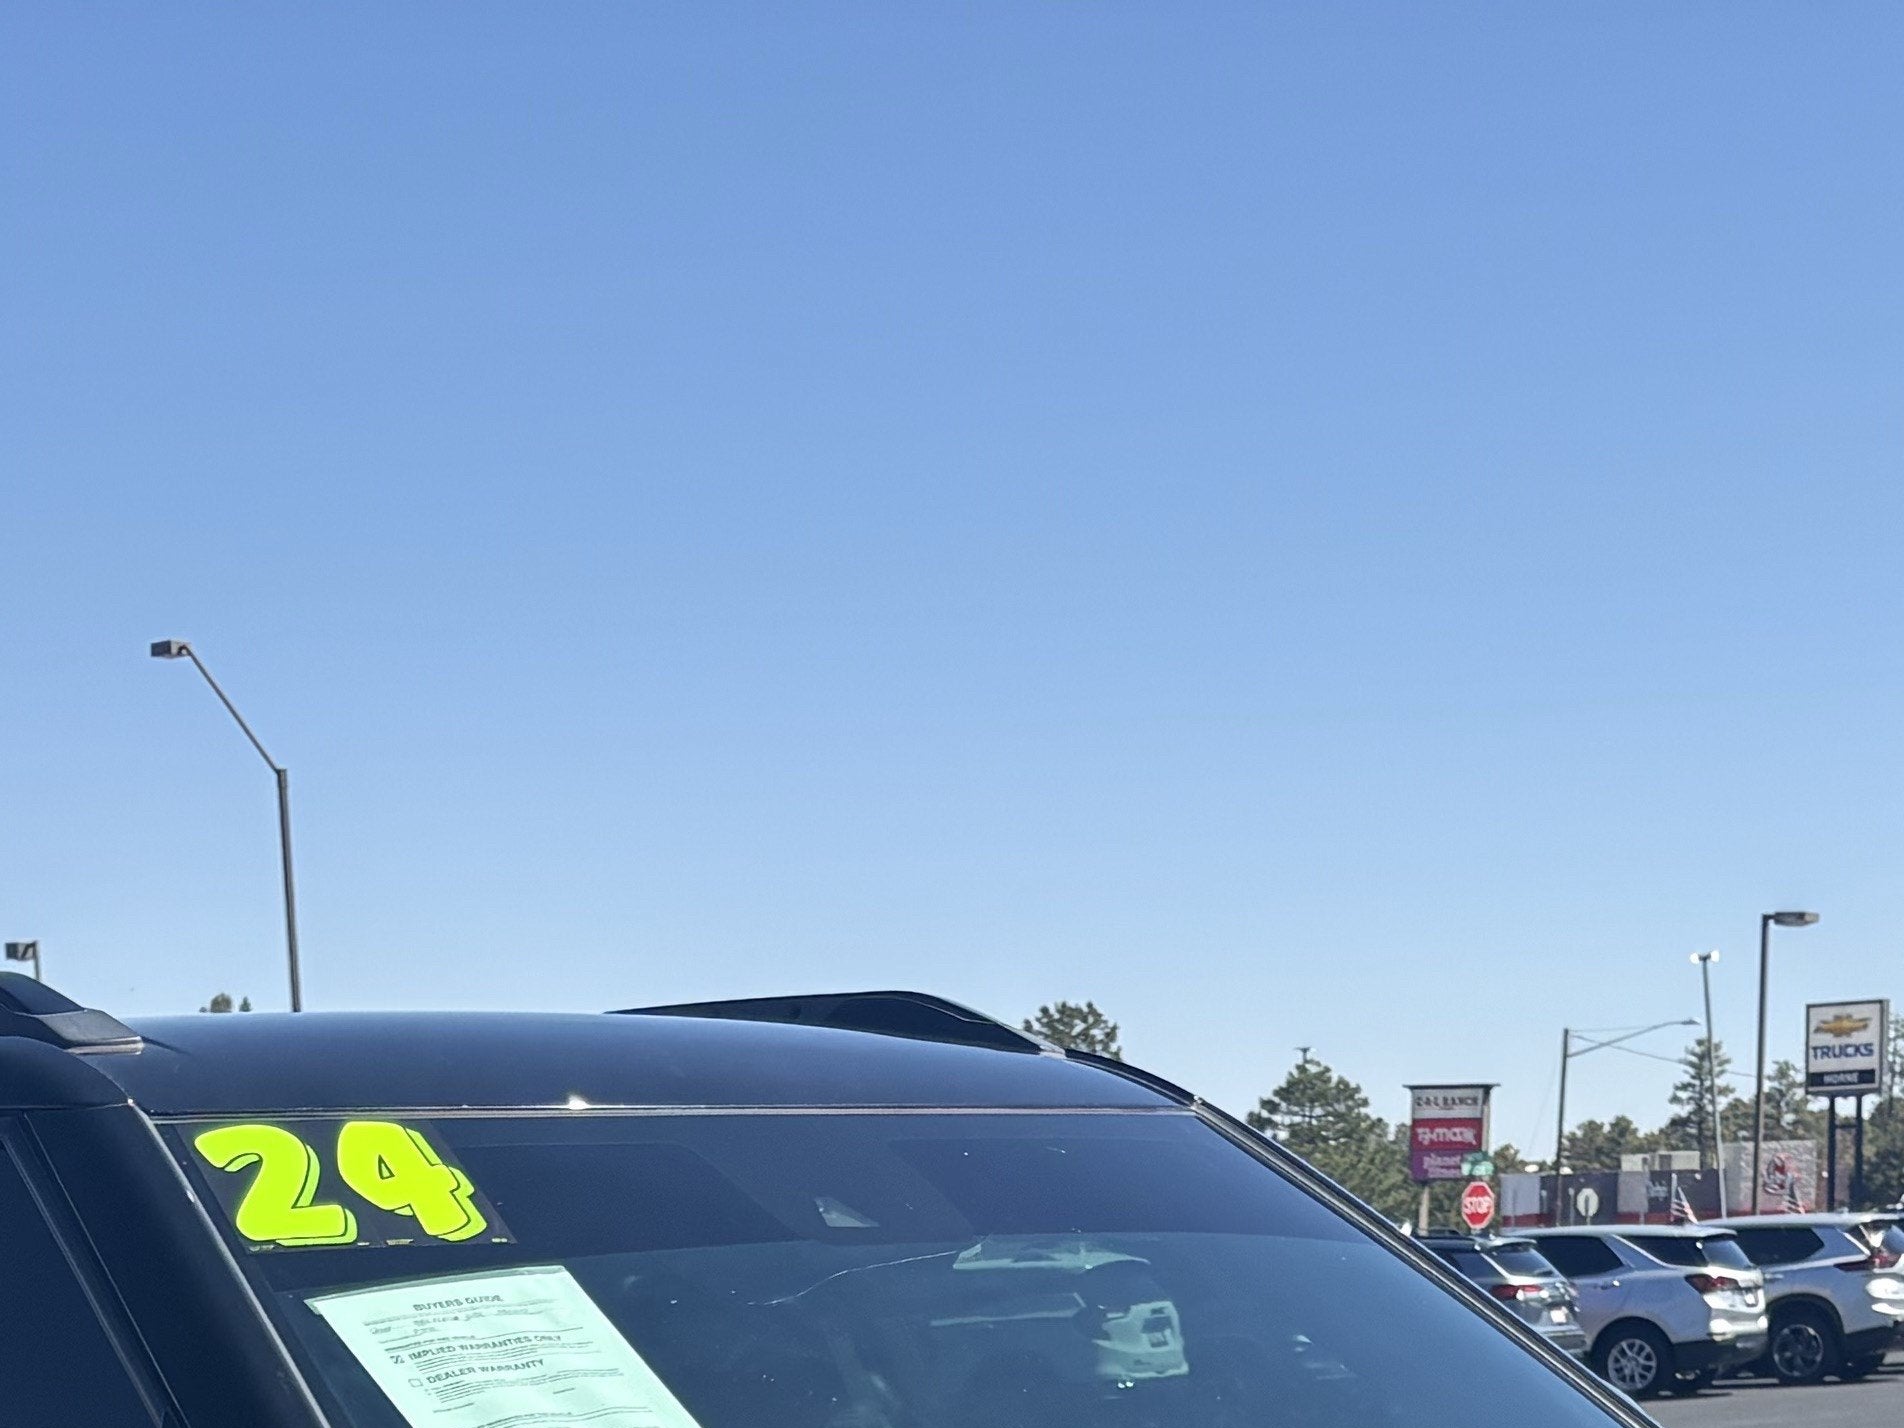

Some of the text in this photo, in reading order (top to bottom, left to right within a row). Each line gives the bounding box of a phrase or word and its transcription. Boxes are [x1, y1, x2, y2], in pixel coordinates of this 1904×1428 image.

[1811, 1042, 1874, 1060] TRUCKS
[194, 1121, 487, 1247] 24
[1462, 1196, 1493, 1215] STOP
[412, 1298, 463, 1311] BUYERS
[408, 1345, 457, 1361] IMPLIED
[458, 1335, 532, 1351] WARRANTIES
[426, 1358, 545, 1384] DEALER WARRANTY
